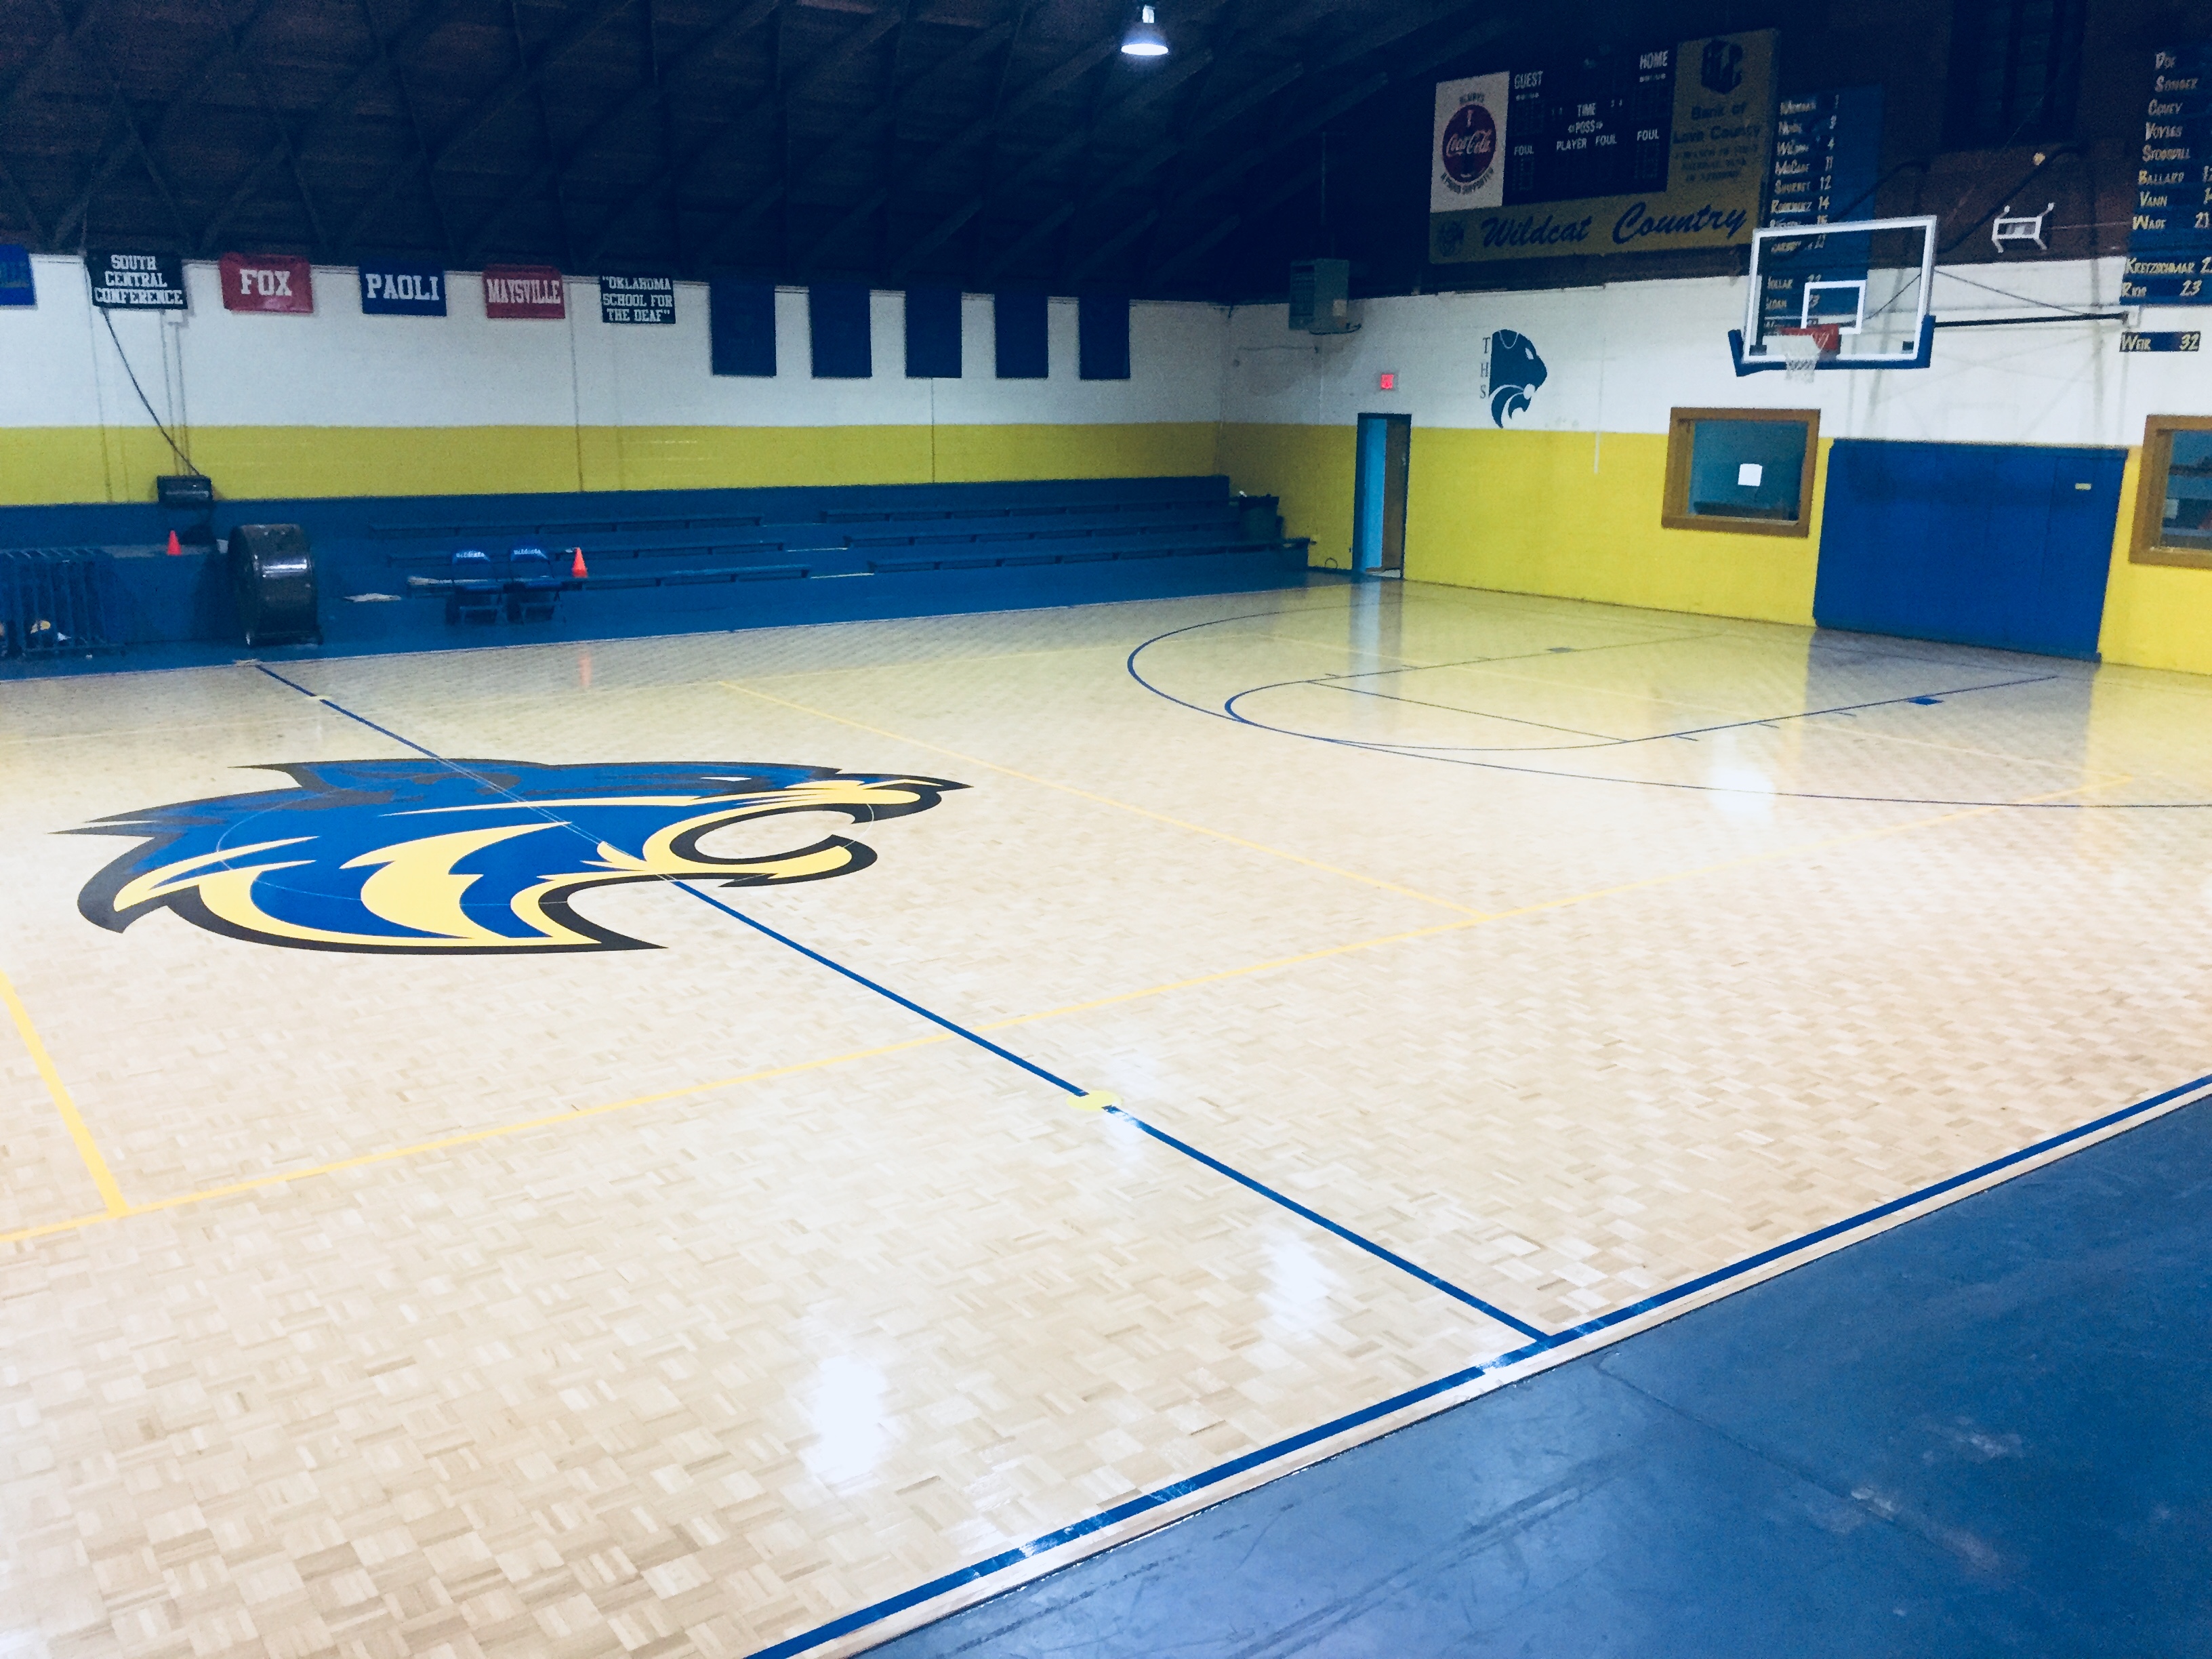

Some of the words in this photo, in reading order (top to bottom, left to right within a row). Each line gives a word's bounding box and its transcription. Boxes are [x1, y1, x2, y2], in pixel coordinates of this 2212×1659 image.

[1639, 50, 1669, 70] HOME
[1514, 70, 1544, 89] GUEST
[1577, 102, 1597, 118] TIME
[1690, 103, 1725, 120] Bank
[1556, 138, 1587, 151] PLAYER
[1595, 134, 1617, 146] FOUL
[1637, 128, 1660, 142] FOUL
[1513, 144, 1534, 156] FOUL
[1820, 175, 1831, 190] 12
[1818, 195, 1830, 210] 14
[2139, 190, 2168, 208] VANN
[1481, 215, 1593, 248] Wildcat
[1612, 201, 1747, 245] Country
[2194, 211, 2210, 228] 21
[110, 254, 157, 270] SOUTH
[104, 270, 167, 287] CENTRAL
[239, 268, 292, 296] FOX
[365, 273, 439, 301] PAOLI
[94, 287, 184, 305] CONFERENCE
[487, 279, 561, 304] MAYSVILLE
[2179, 280, 2203, 297] 23
[602, 293, 647, 307] SCHOOL
[650, 294, 673, 308] FOR
[606, 308, 630, 322] THE
[2121, 334, 2152, 350] WEIR
[2179, 333, 2200, 350] 32
